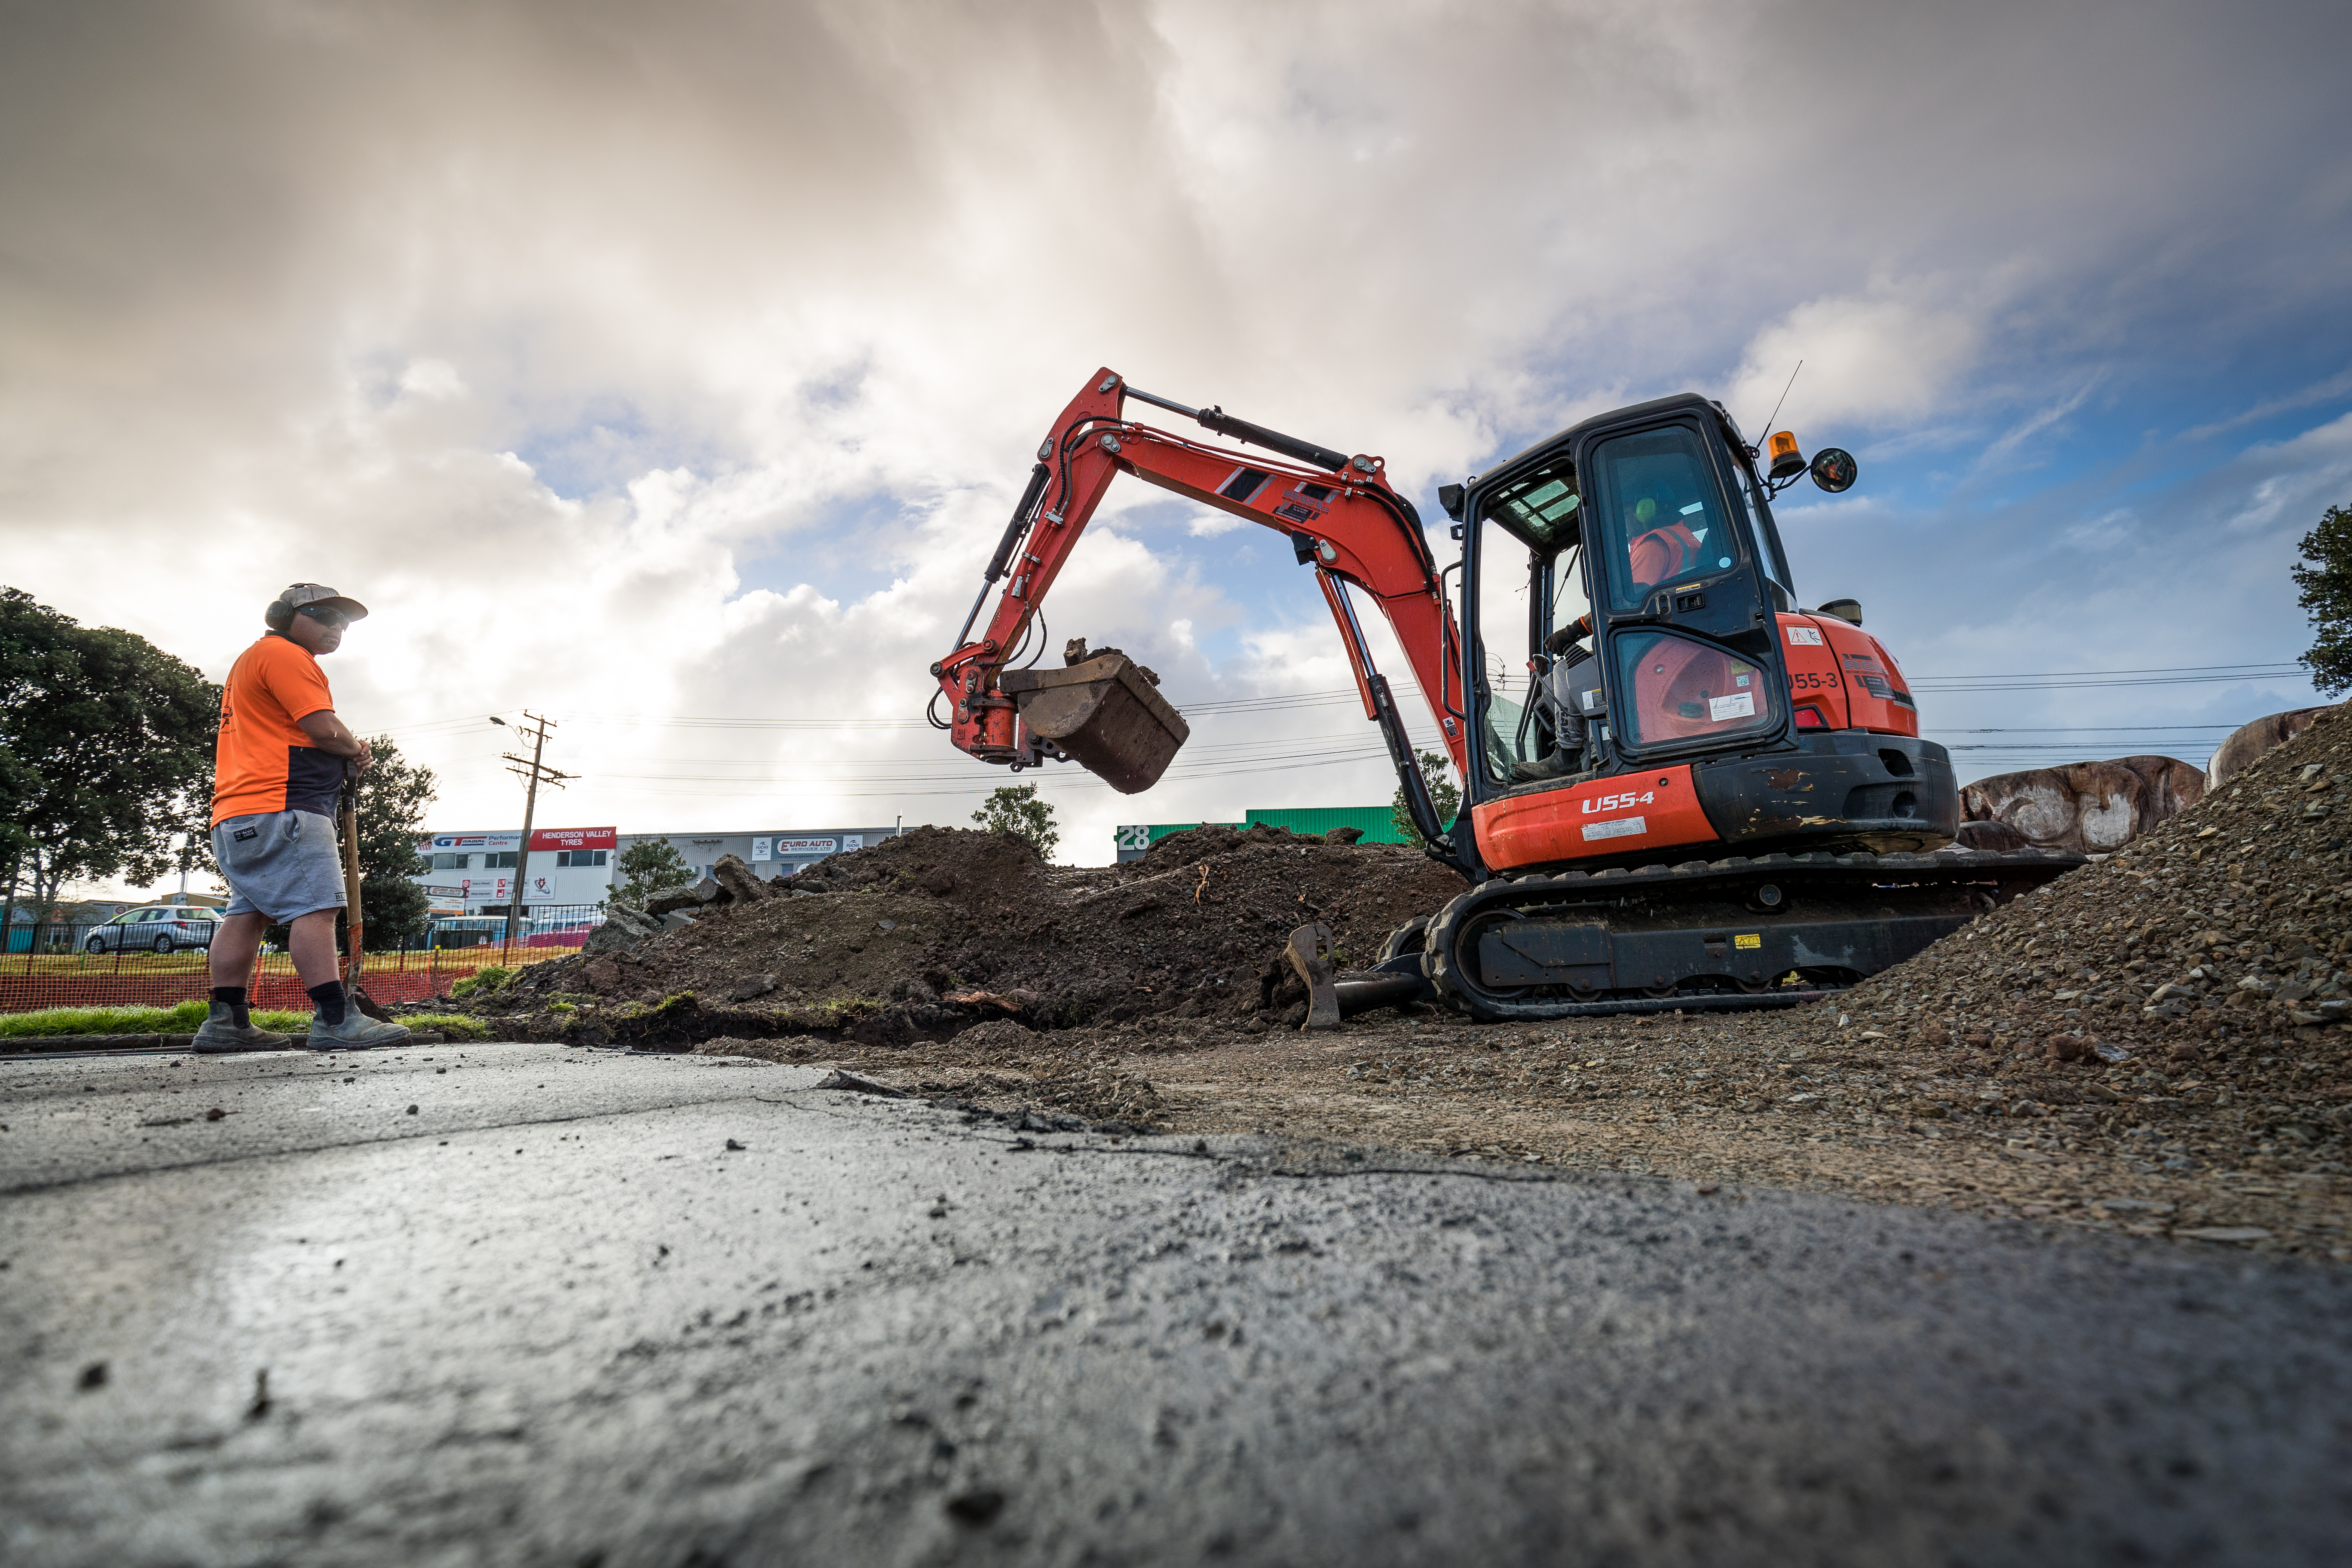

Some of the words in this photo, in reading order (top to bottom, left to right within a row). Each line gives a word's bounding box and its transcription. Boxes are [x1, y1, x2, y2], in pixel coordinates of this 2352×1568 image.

[1283, 490, 1329, 511] ACL
[781, 841, 807, 851] EURO
[1118, 825, 1150, 851] 28
